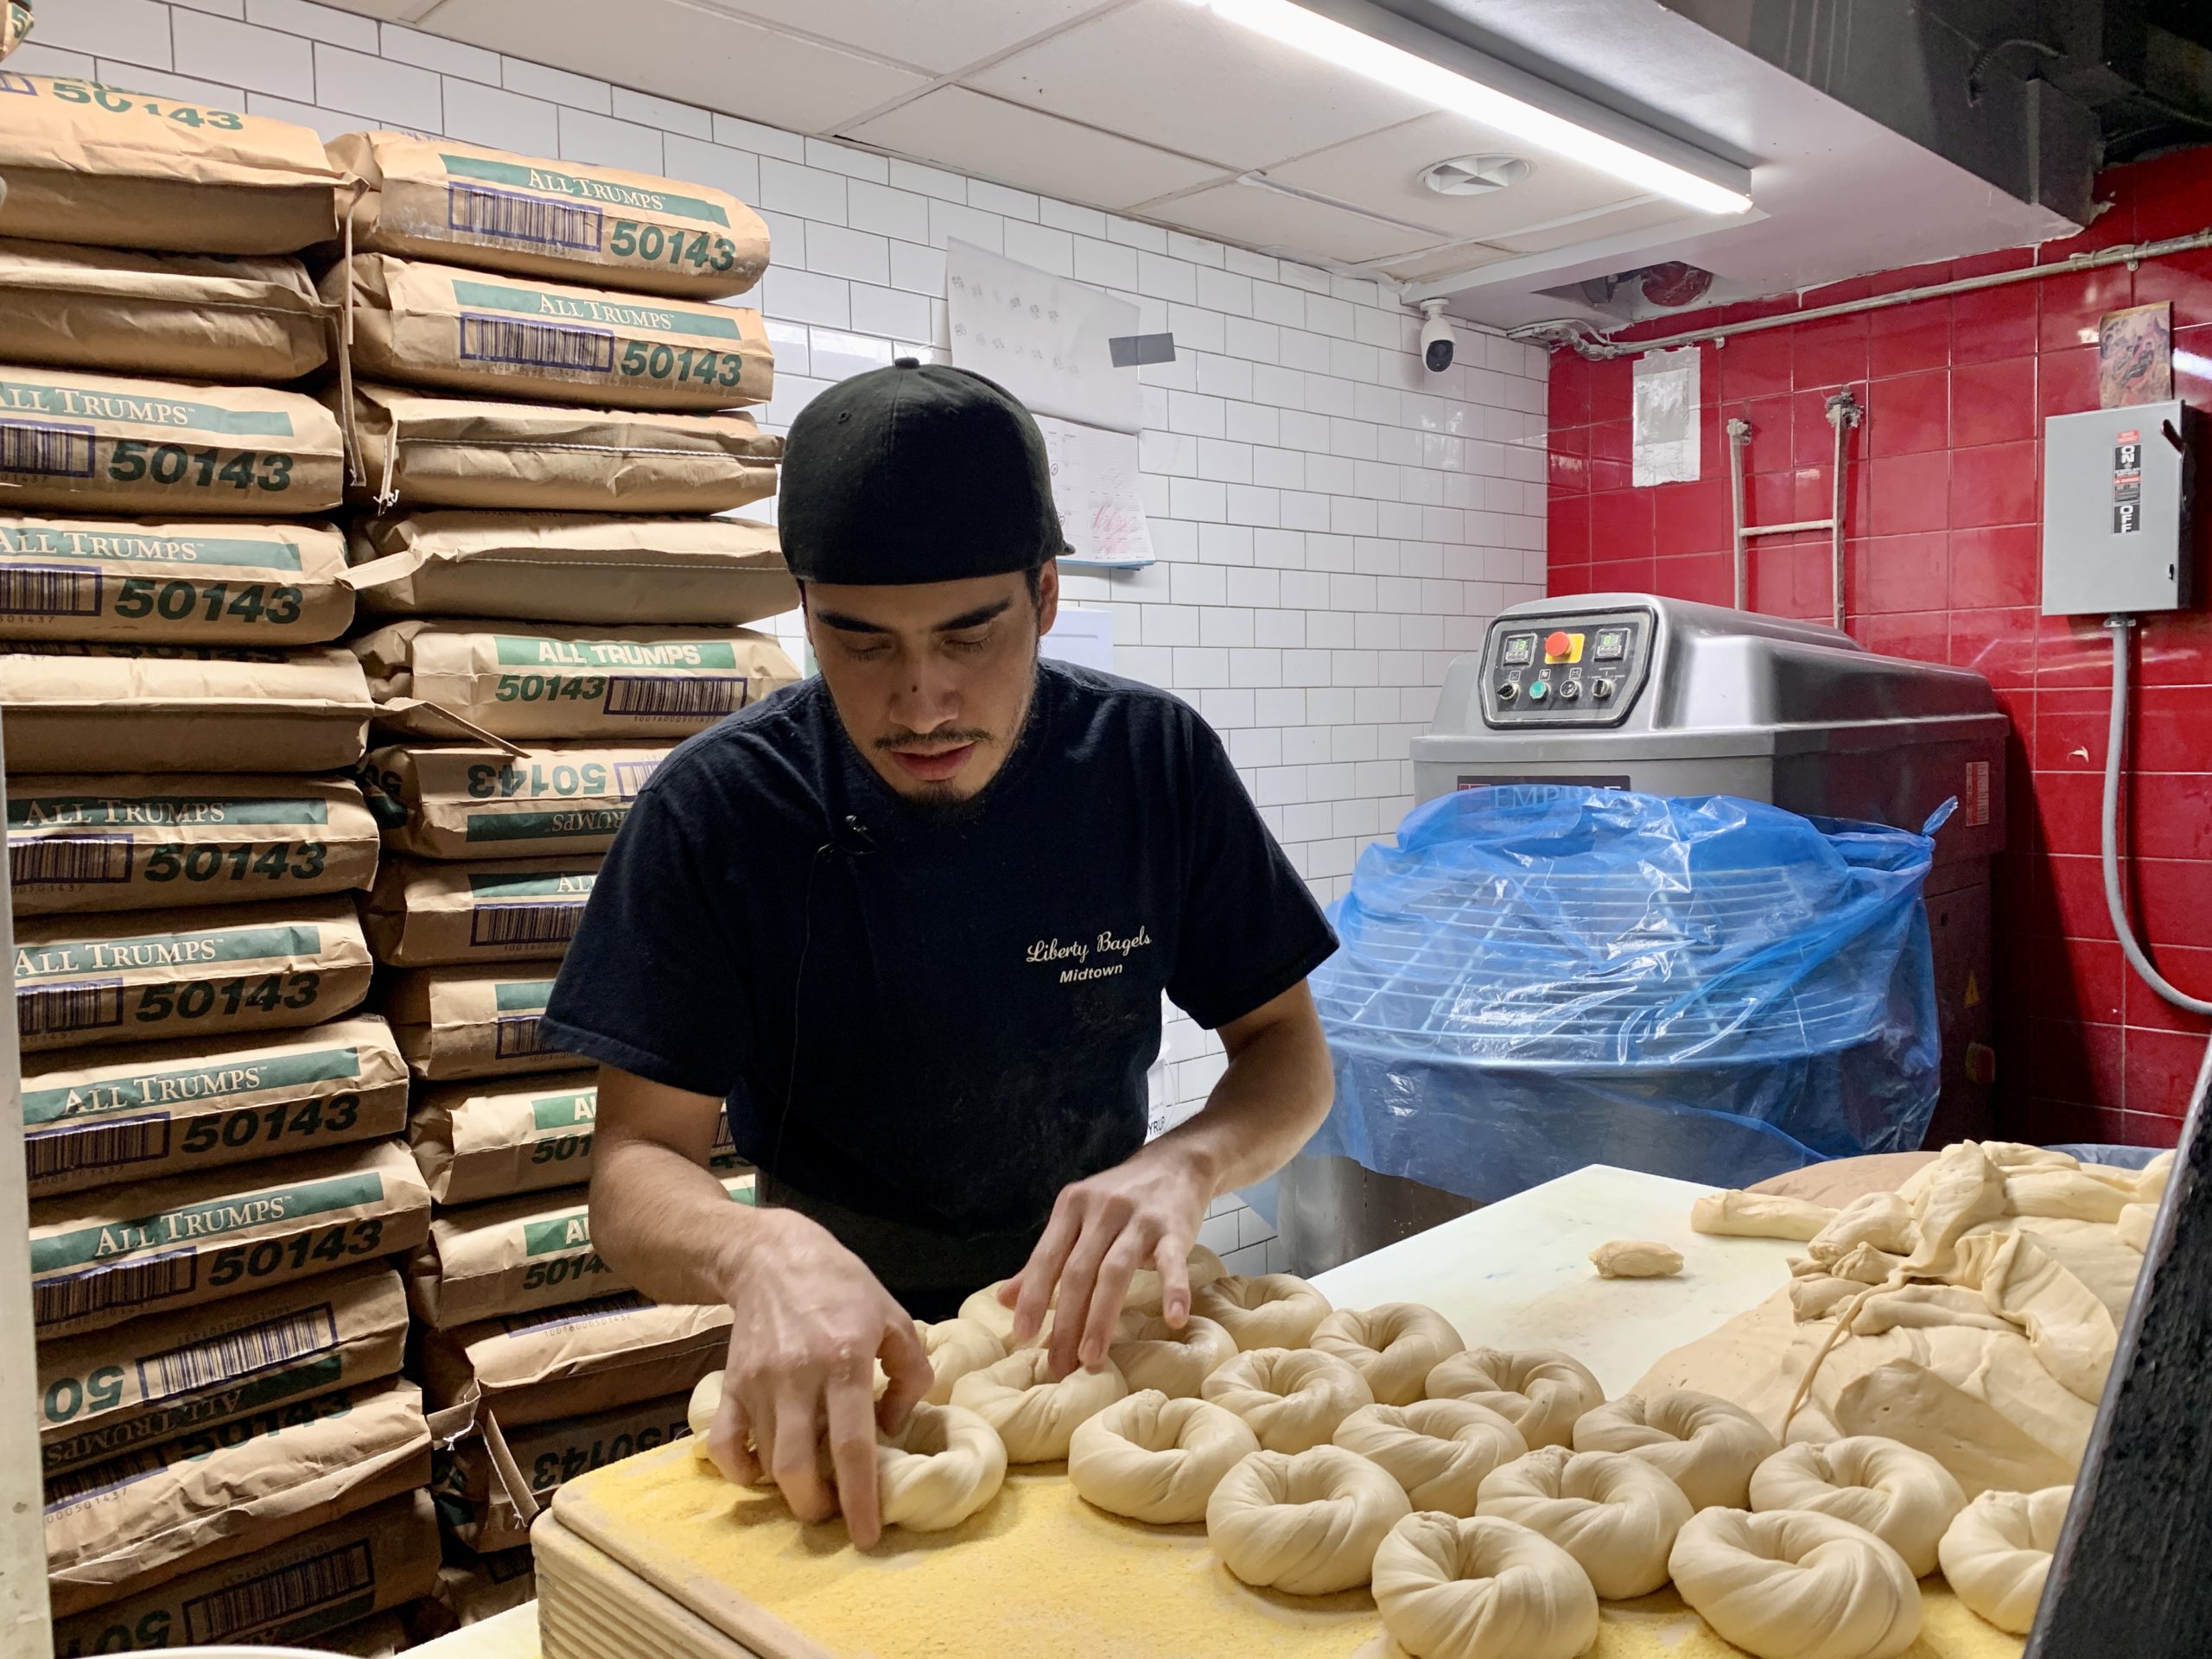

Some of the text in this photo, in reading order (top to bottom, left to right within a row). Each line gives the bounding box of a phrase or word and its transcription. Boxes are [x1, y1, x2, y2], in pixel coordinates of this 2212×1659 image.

[53, 82, 244, 130] 50143
[527, 168, 569, 194] ALL
[610, 221, 736, 271] 50143
[538, 293, 583, 318] ALL
[620, 340, 743, 387] 50143
[108, 440, 294, 492] 50143
[2121, 445, 2135, 464] ON
[2120, 505, 2134, 534] OFF
[115, 576, 304, 624] 50143
[537, 640, 588, 665] ALL
[495, 674, 607, 702] 50143
[467, 763, 607, 799] 50143
[1494, 785, 1622, 808] EMPI
[23, 800, 92, 827] ALL
[143, 842, 328, 883] 50143
[1026, 925, 1152, 963] Liberty Bagels
[14, 949, 79, 977] ALL
[1059, 963, 1123, 983] Midtown
[136, 972, 321, 1023] 50143
[64, 1087, 128, 1116] ALL
[181, 1094, 361, 1154] 50143
[94, 1225, 158, 1257] ALL
[207, 1218, 384, 1287] 50143
[188, 1389, 244, 1422] ALL
